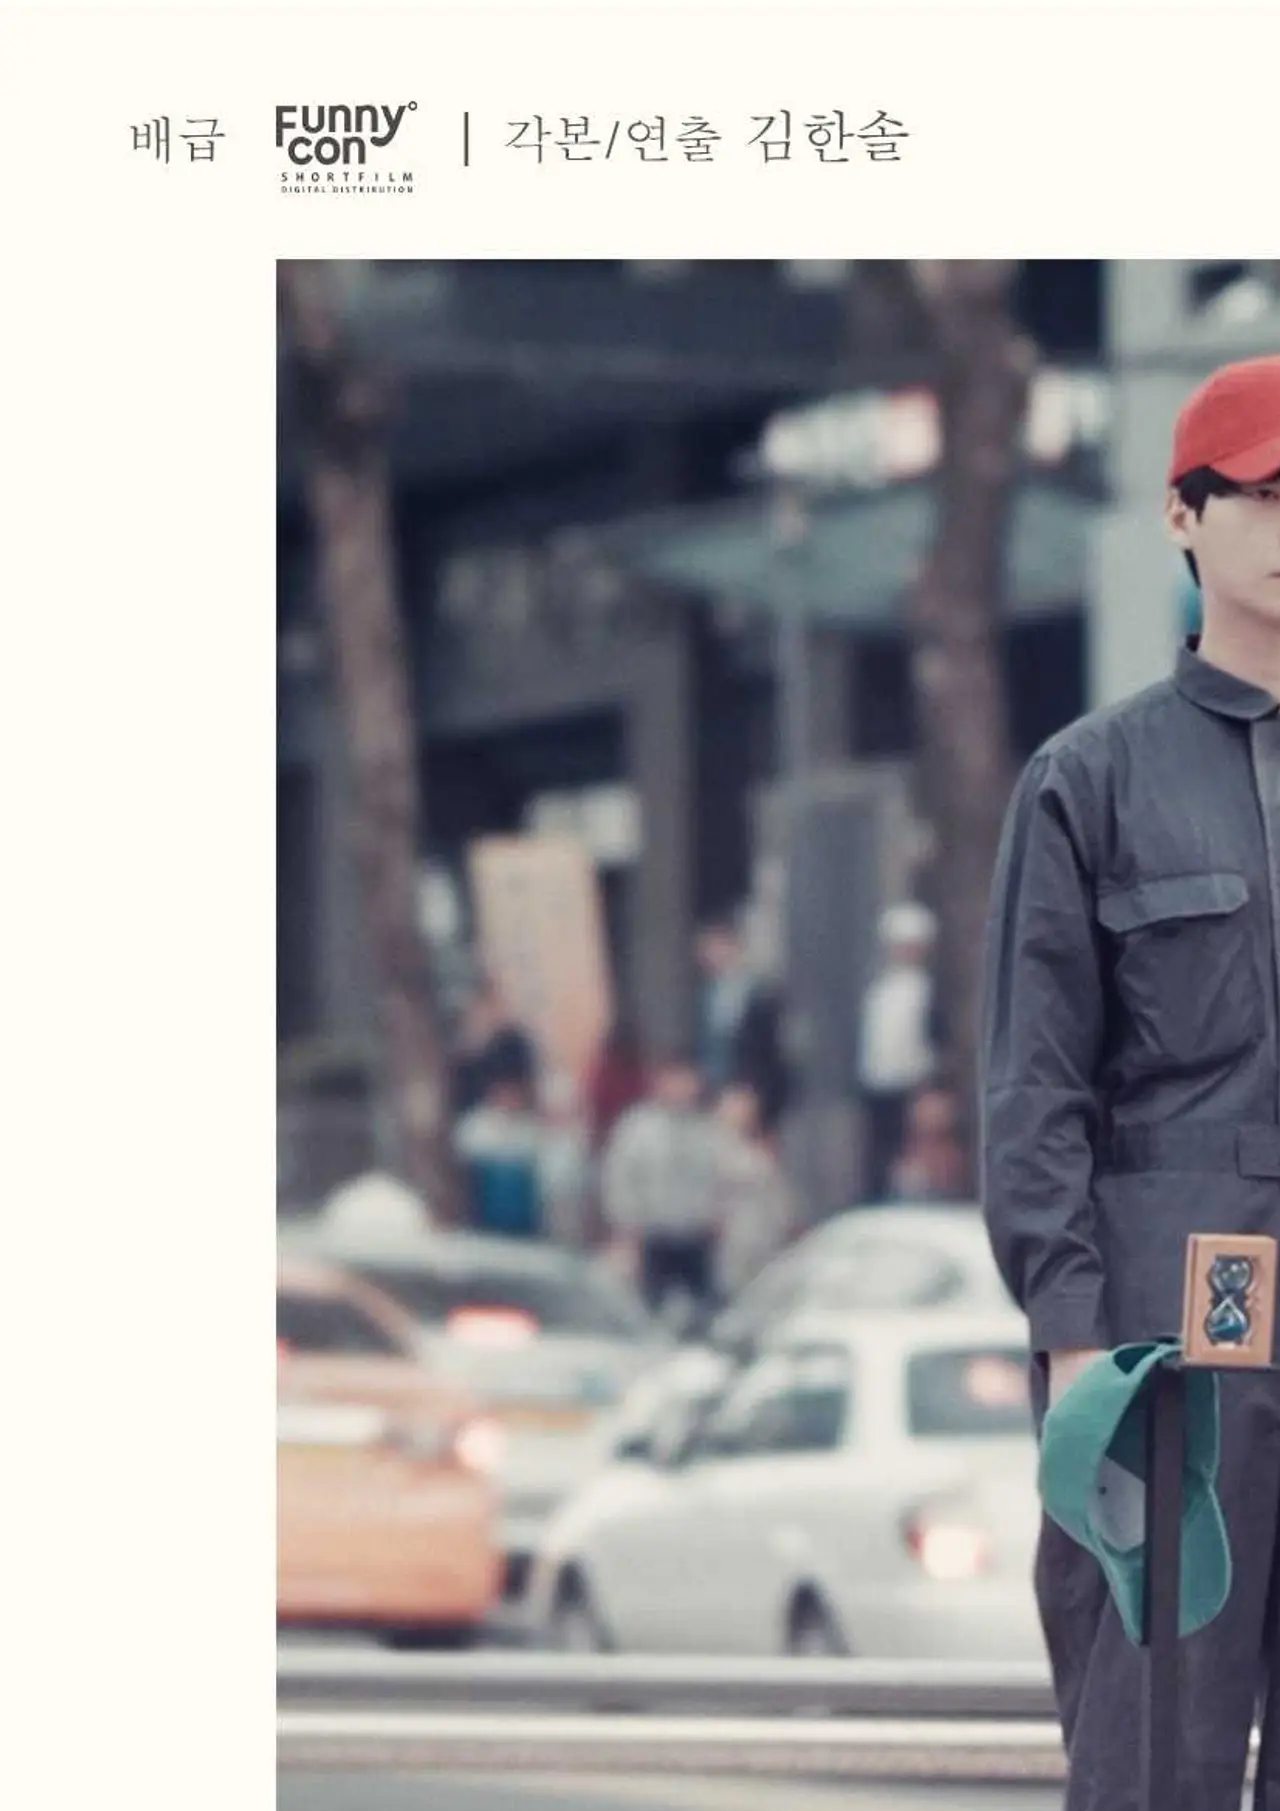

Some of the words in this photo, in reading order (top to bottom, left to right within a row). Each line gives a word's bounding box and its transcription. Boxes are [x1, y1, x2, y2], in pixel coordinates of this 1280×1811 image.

[130, 115, 227, 165] 배급
[276, 103, 407, 147] Funny
[505, 115, 723, 165] 각본/연출
[748, 109, 911, 164] 김한솔
[288, 136, 367, 166] con
[281, 185, 326, 194] DIGITAL
[331, 185, 414, 194] DISTRIBUTION
